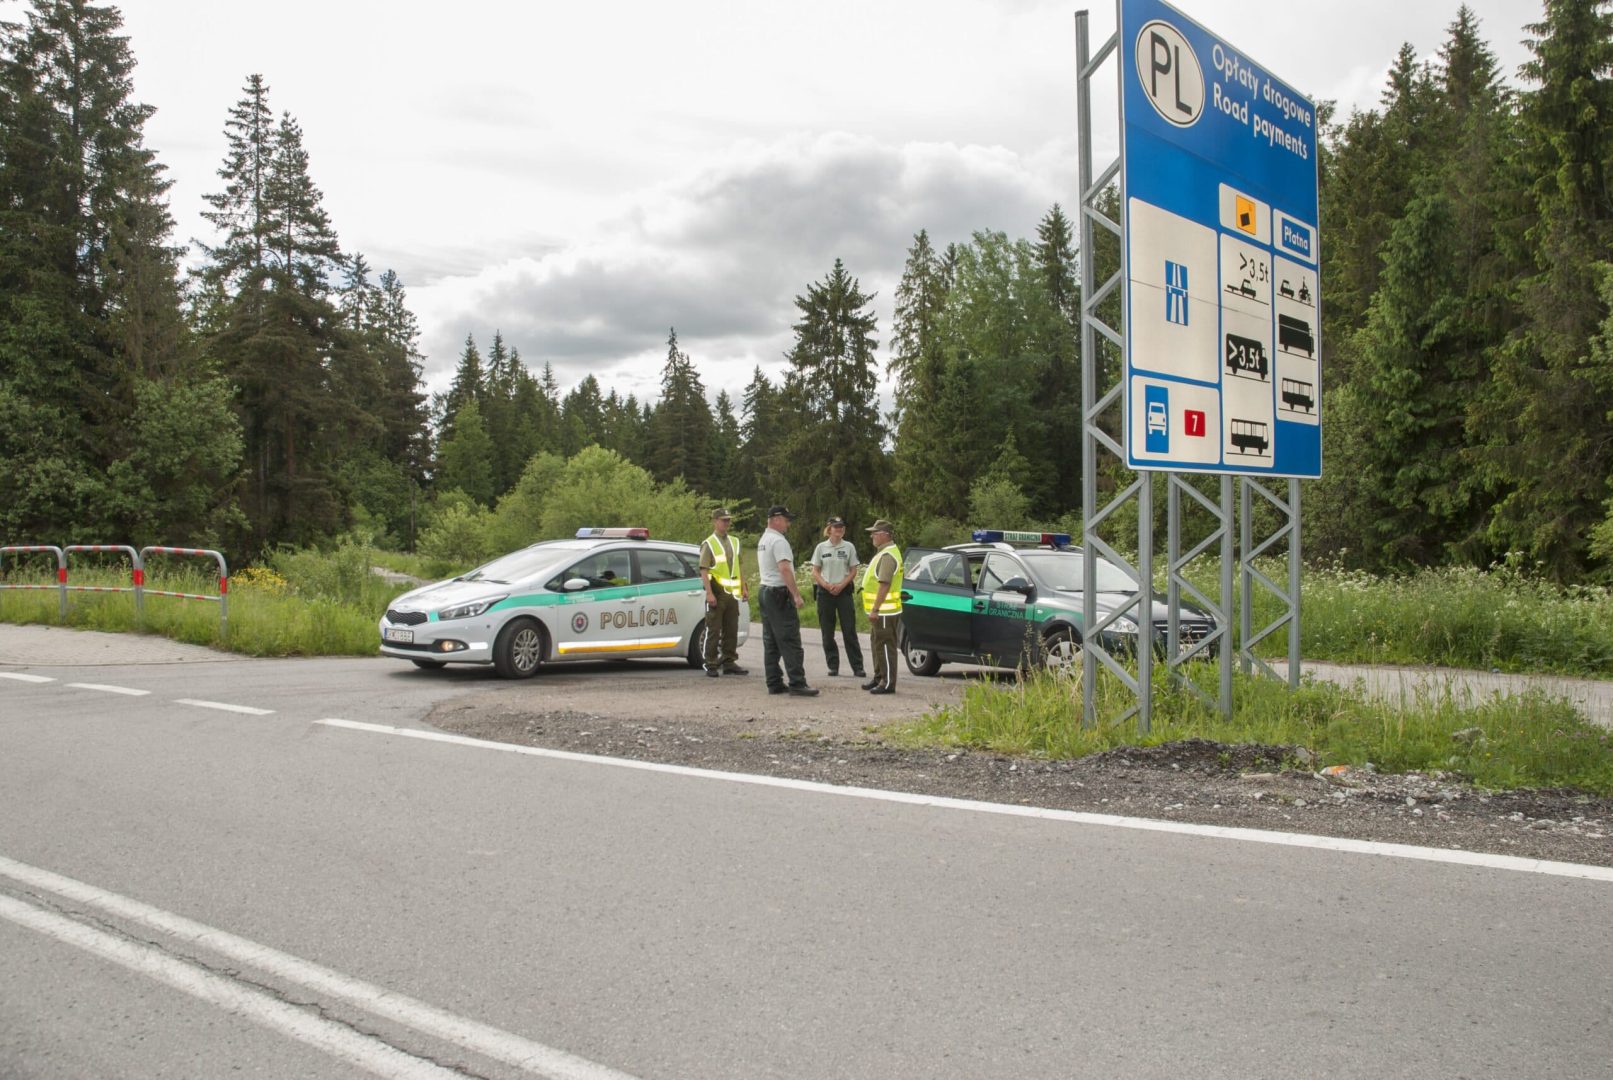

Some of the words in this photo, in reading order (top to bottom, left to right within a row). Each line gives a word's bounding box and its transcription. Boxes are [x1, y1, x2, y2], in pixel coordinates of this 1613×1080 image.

[1151, 31, 1192, 116] PL
[1213, 44, 1258, 100] Opłaty
[1263, 79, 1311, 128] drogowe
[1213, 82, 1248, 126] Road
[1253, 113, 1308, 160] payments
[1284, 225, 1308, 250] Płatna
[1191, 414, 1199, 433] 7
[600, 605, 678, 630] POLÍCIA
